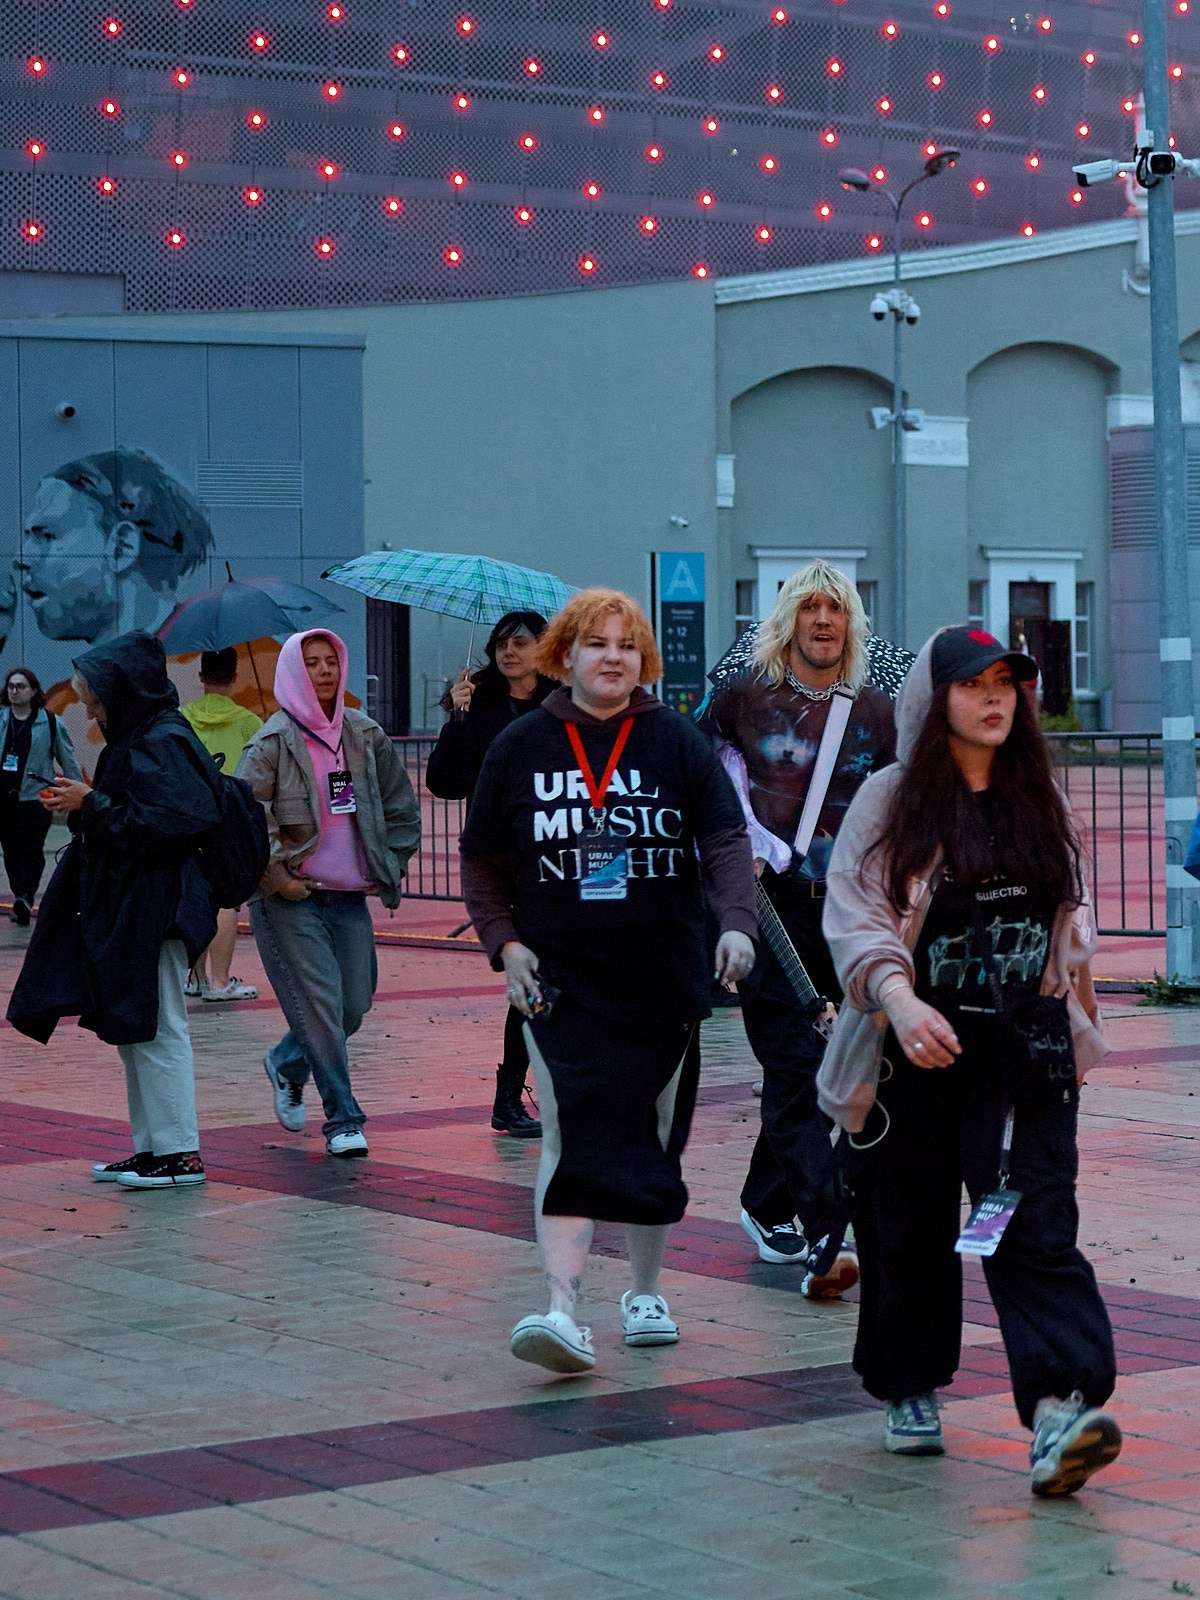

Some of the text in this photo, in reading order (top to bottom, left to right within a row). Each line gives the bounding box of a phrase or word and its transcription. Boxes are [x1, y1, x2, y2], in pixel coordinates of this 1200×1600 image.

[667, 560, 699, 596] A
[534, 769, 659, 801] URAL
[534, 805, 683, 842] MUSIC
[538, 848, 685, 882] NIHT
[588, 852, 614, 861] URAL
[975, 886, 1028, 901] БЩЕСТВО
[981, 1203, 1003, 1213] URAL
